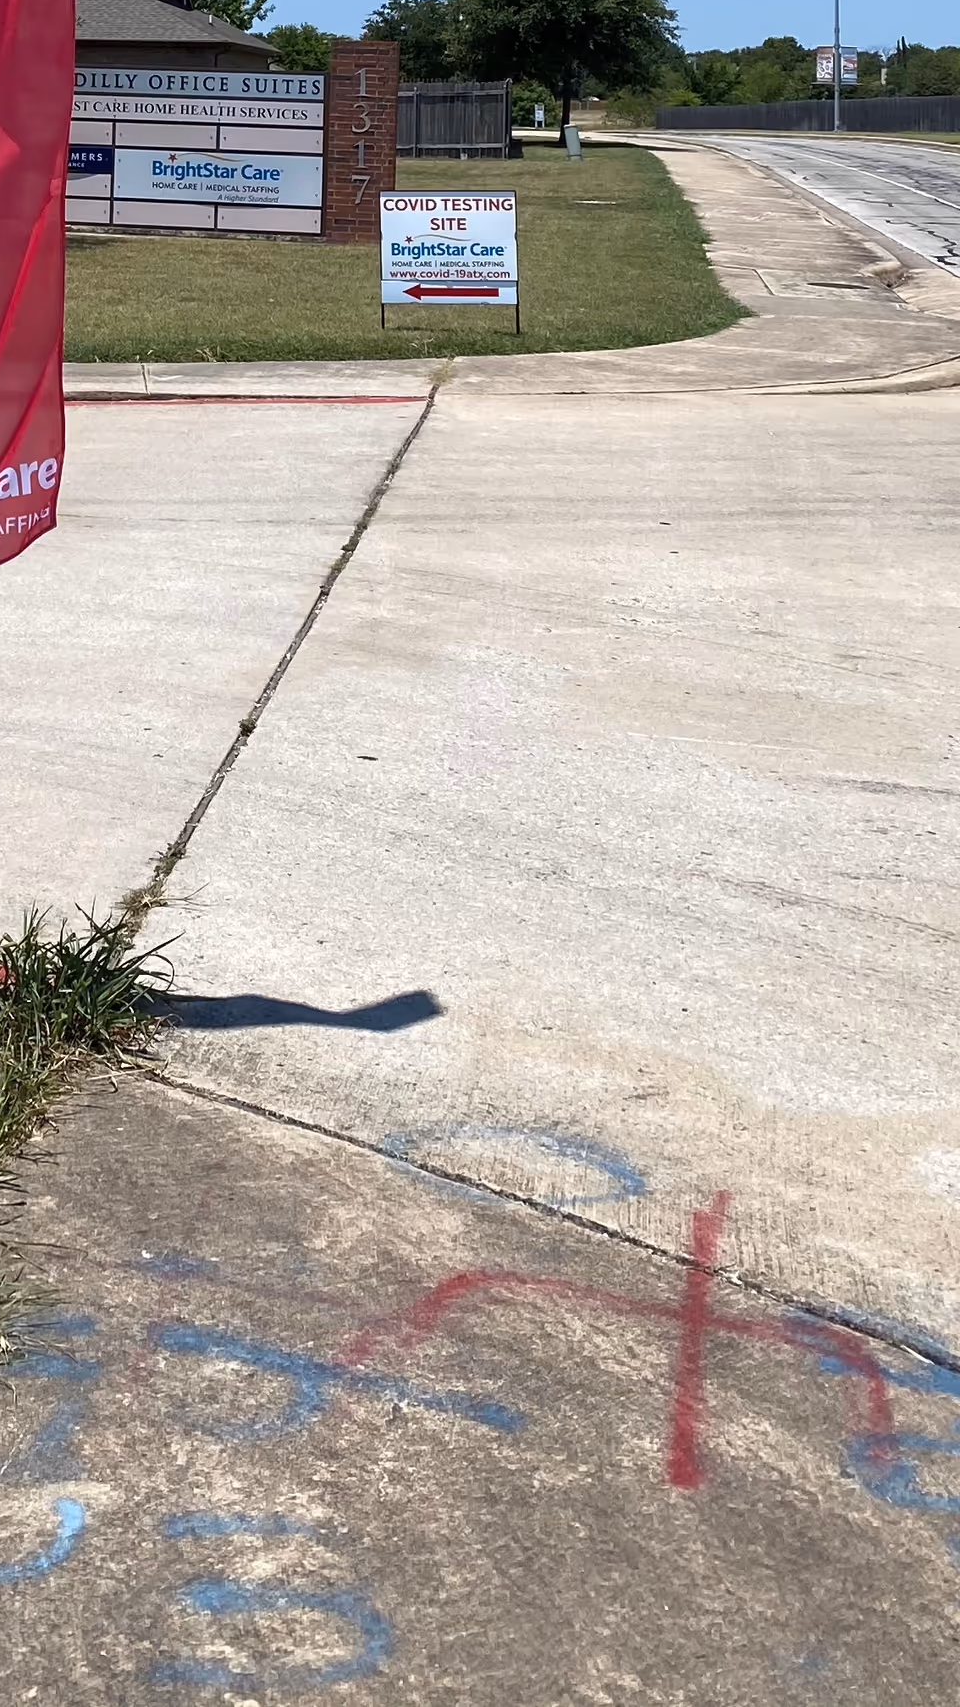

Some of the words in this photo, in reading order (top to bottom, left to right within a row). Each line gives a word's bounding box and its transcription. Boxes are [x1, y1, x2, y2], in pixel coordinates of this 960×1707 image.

[148, 74, 229, 92] OFFICE
[241, 78, 321, 95] SUITES
[93, 101, 130, 113] CARE
[134, 102, 176, 114] HOME
[180, 104, 236, 117] HEALTH
[240, 107, 308, 120] SERVICES
[68, 152, 103, 162] MERS
[152, 160, 238, 180] BrightStar
[241, 164, 280, 180] Care
[152, 181, 176, 190] HOME
[177, 182, 198, 191] CARE
[205, 184, 240, 193] MEDICAL
[242, 185, 280, 194] STAFFING
[383, 198, 437, 211] COVID
[441, 198, 513, 211] TESTING
[430, 218, 467, 231] SITE
[391, 242, 467, 260] BrightStar
[470, 243, 505, 256] Care
[391, 260, 413, 268] HOME
[414, 260, 433, 268] CARE
[390, 269, 511, 279] www.covid-19atx.com
